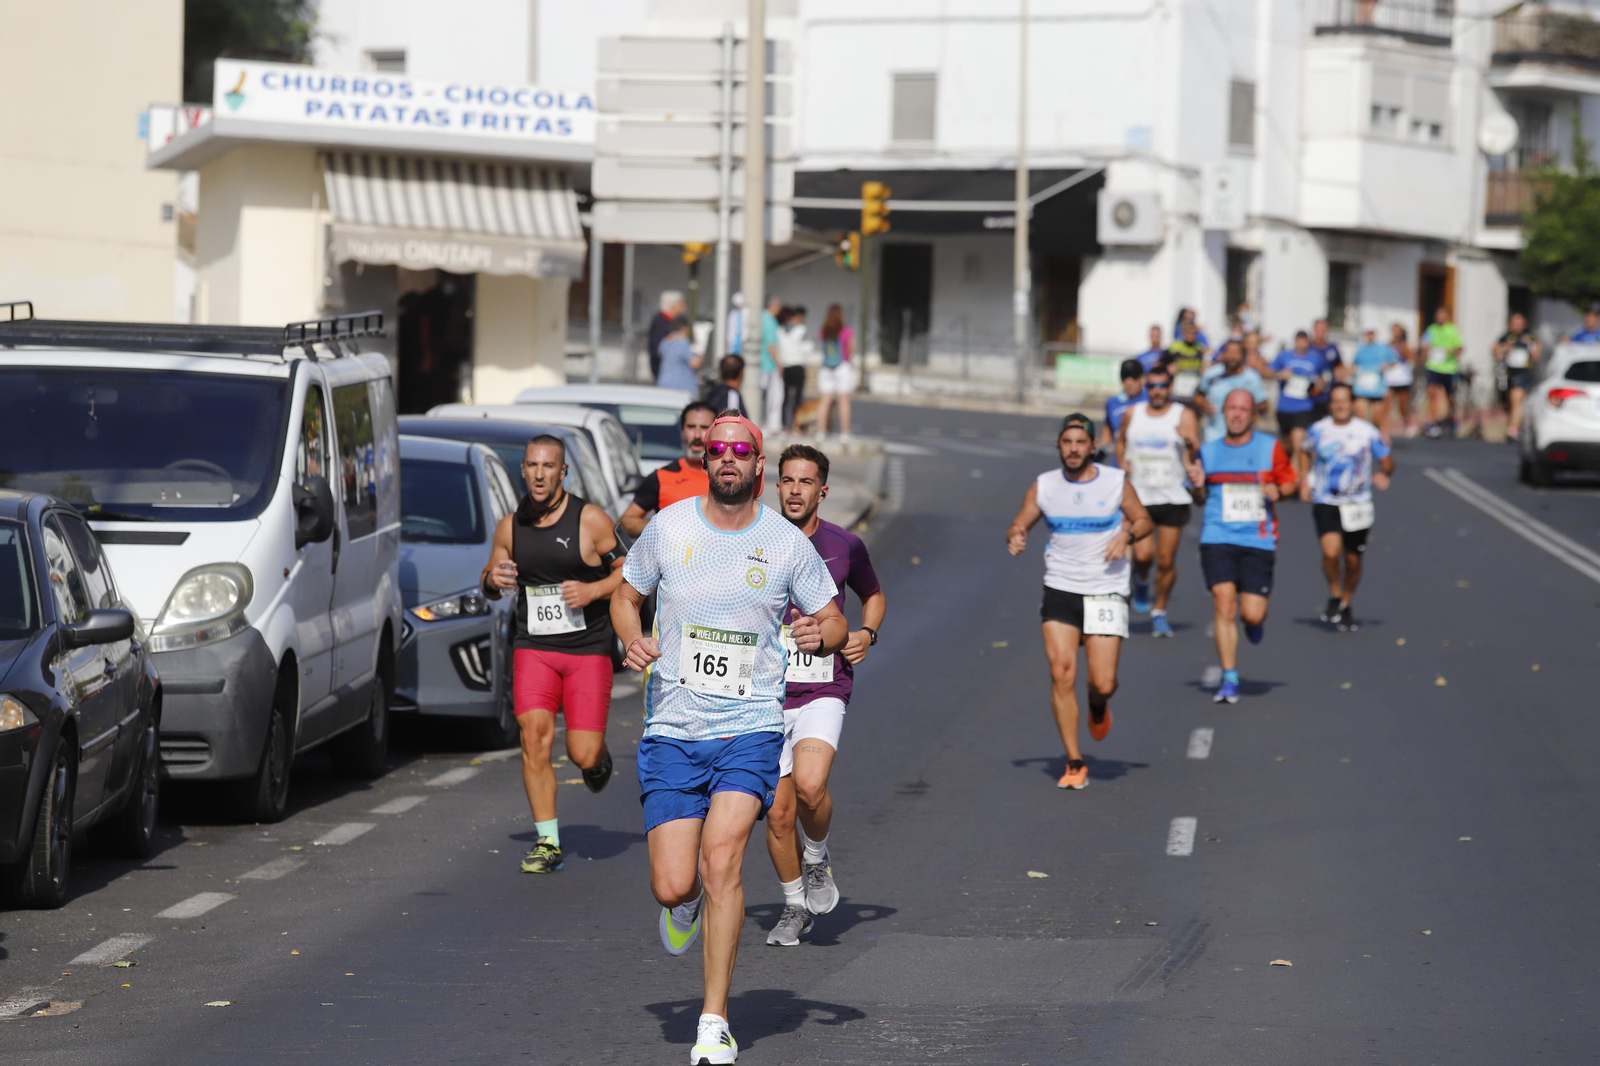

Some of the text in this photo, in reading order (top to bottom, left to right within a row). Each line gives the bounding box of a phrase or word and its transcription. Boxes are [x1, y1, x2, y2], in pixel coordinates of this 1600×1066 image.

[262, 71, 414, 100] CHURROS
[444, 84, 594, 111] CHOCOLA
[304, 99, 573, 136] PATATAS FRITAS
[537, 605, 563, 621] 663
[1098, 608, 1114, 622] 83
[696, 628, 720, 642] VUELTA
[721, 633, 727, 643] A
[728, 634, 752, 645] HUELA
[693, 652, 729, 677] 165
